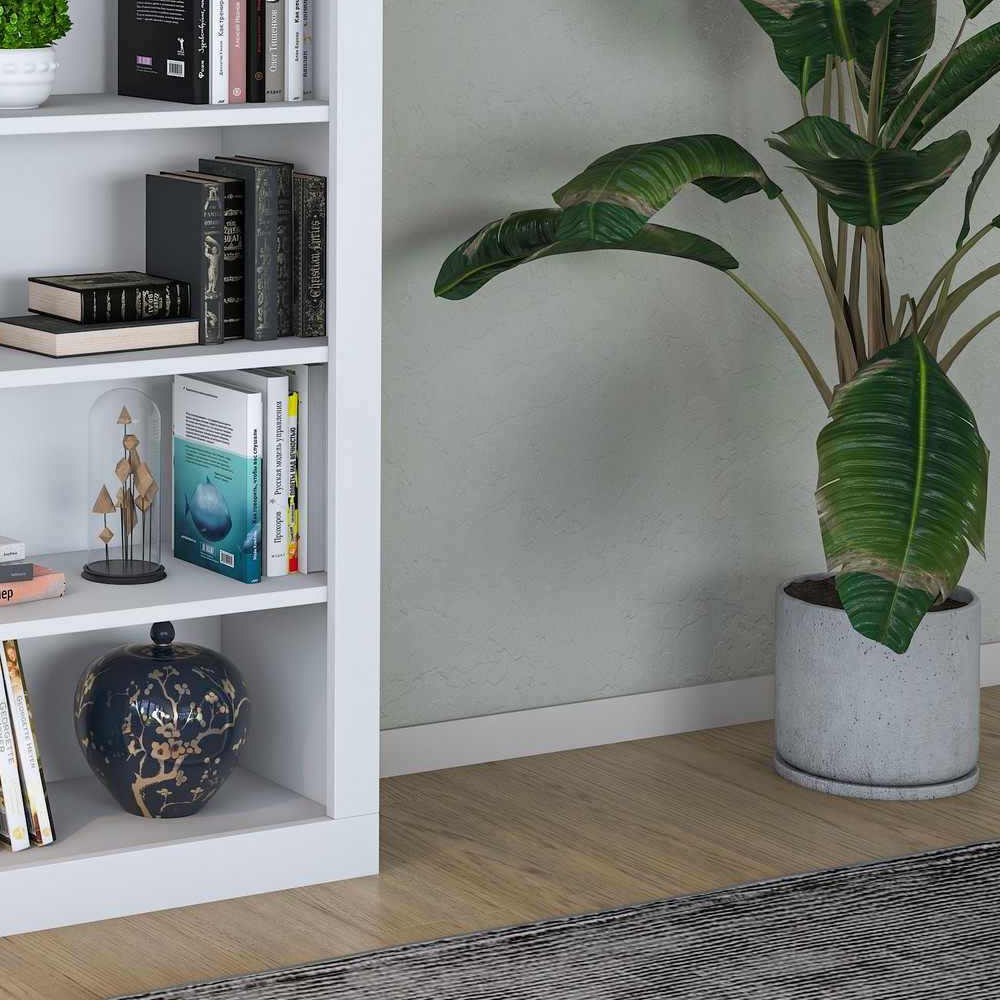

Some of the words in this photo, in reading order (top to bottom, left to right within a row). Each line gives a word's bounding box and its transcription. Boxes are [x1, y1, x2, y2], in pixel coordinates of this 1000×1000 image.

[270, 9, 278, 52] Тищенков
[270, 53, 278, 73] Олег
[308, 252, 322, 298] Christian
[275, 401, 284, 442] управления
[276, 442, 284, 468] модель
[274, 468, 284, 496] Русская
[274, 511, 284, 544] Прохоров
[0, 701, 16, 766] GEORGETTE
[16, 695, 32, 742] GEORGETTE
[26, 742, 36, 770] HEYER
